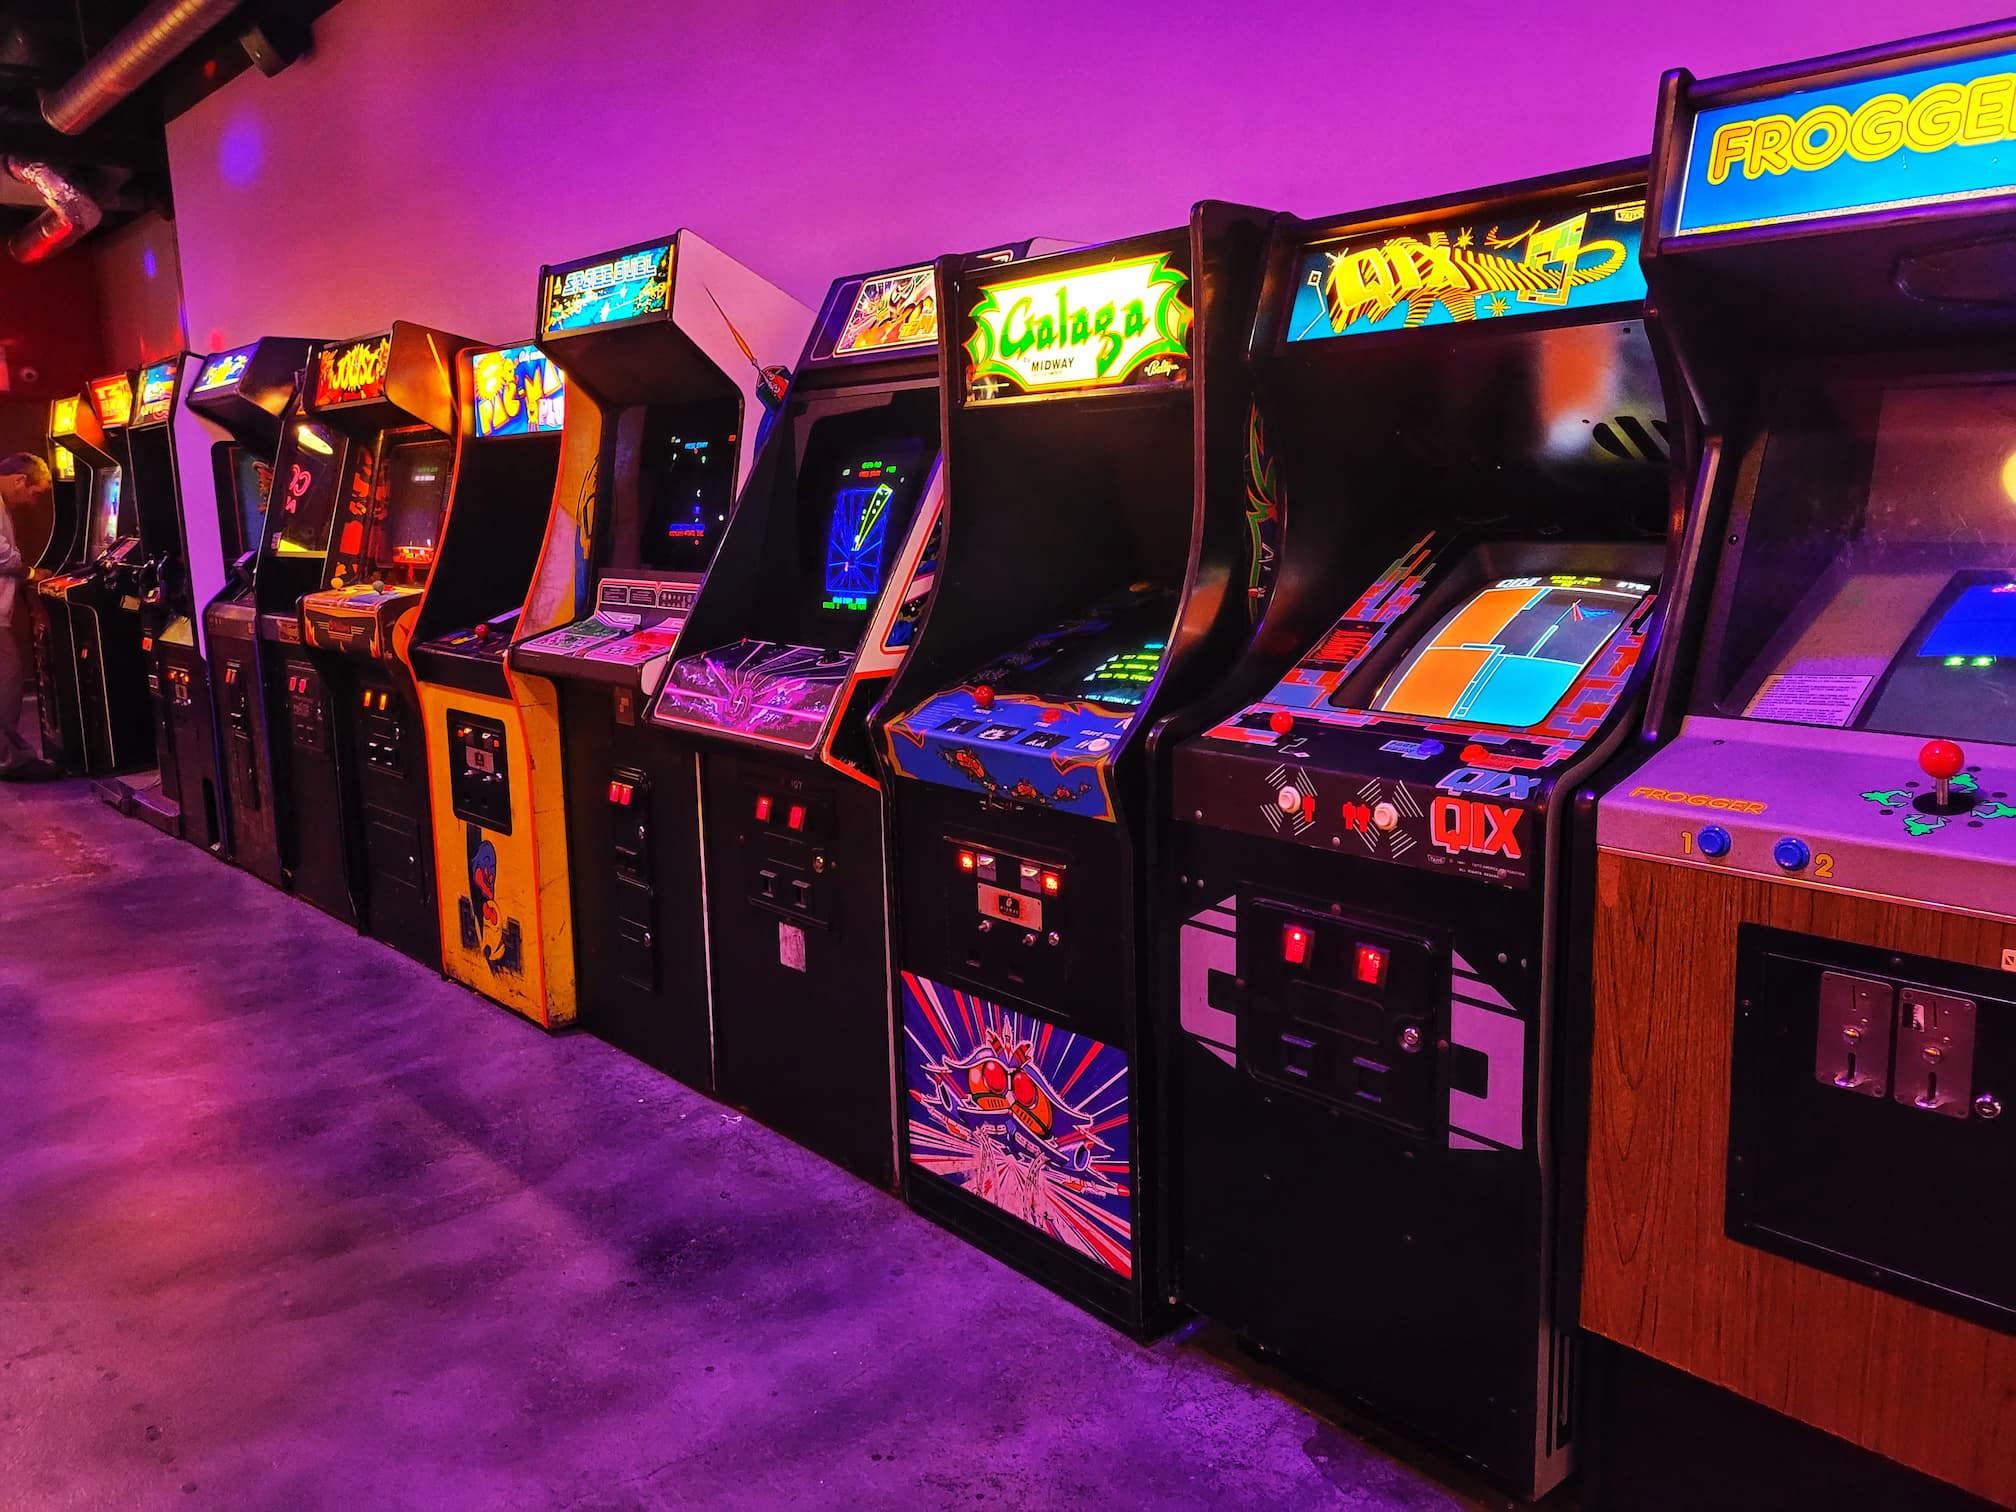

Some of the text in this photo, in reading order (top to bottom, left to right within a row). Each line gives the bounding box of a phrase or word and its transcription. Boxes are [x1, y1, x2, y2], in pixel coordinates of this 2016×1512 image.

[1707, 73, 2016, 185] FROGGE
[562, 253, 657, 296] SPACE DUEL
[1326, 239, 1470, 326] QIX
[999, 285, 1151, 382] Galaga
[333, 344, 379, 390] JOUST
[1031, 357, 1075, 372] MIDWAY
[1435, 767, 1541, 800] QIX
[1629, 786, 1768, 815] FROGGER
[1430, 796, 1524, 859] QIX
[1682, 831, 1834, 878] 1 2
